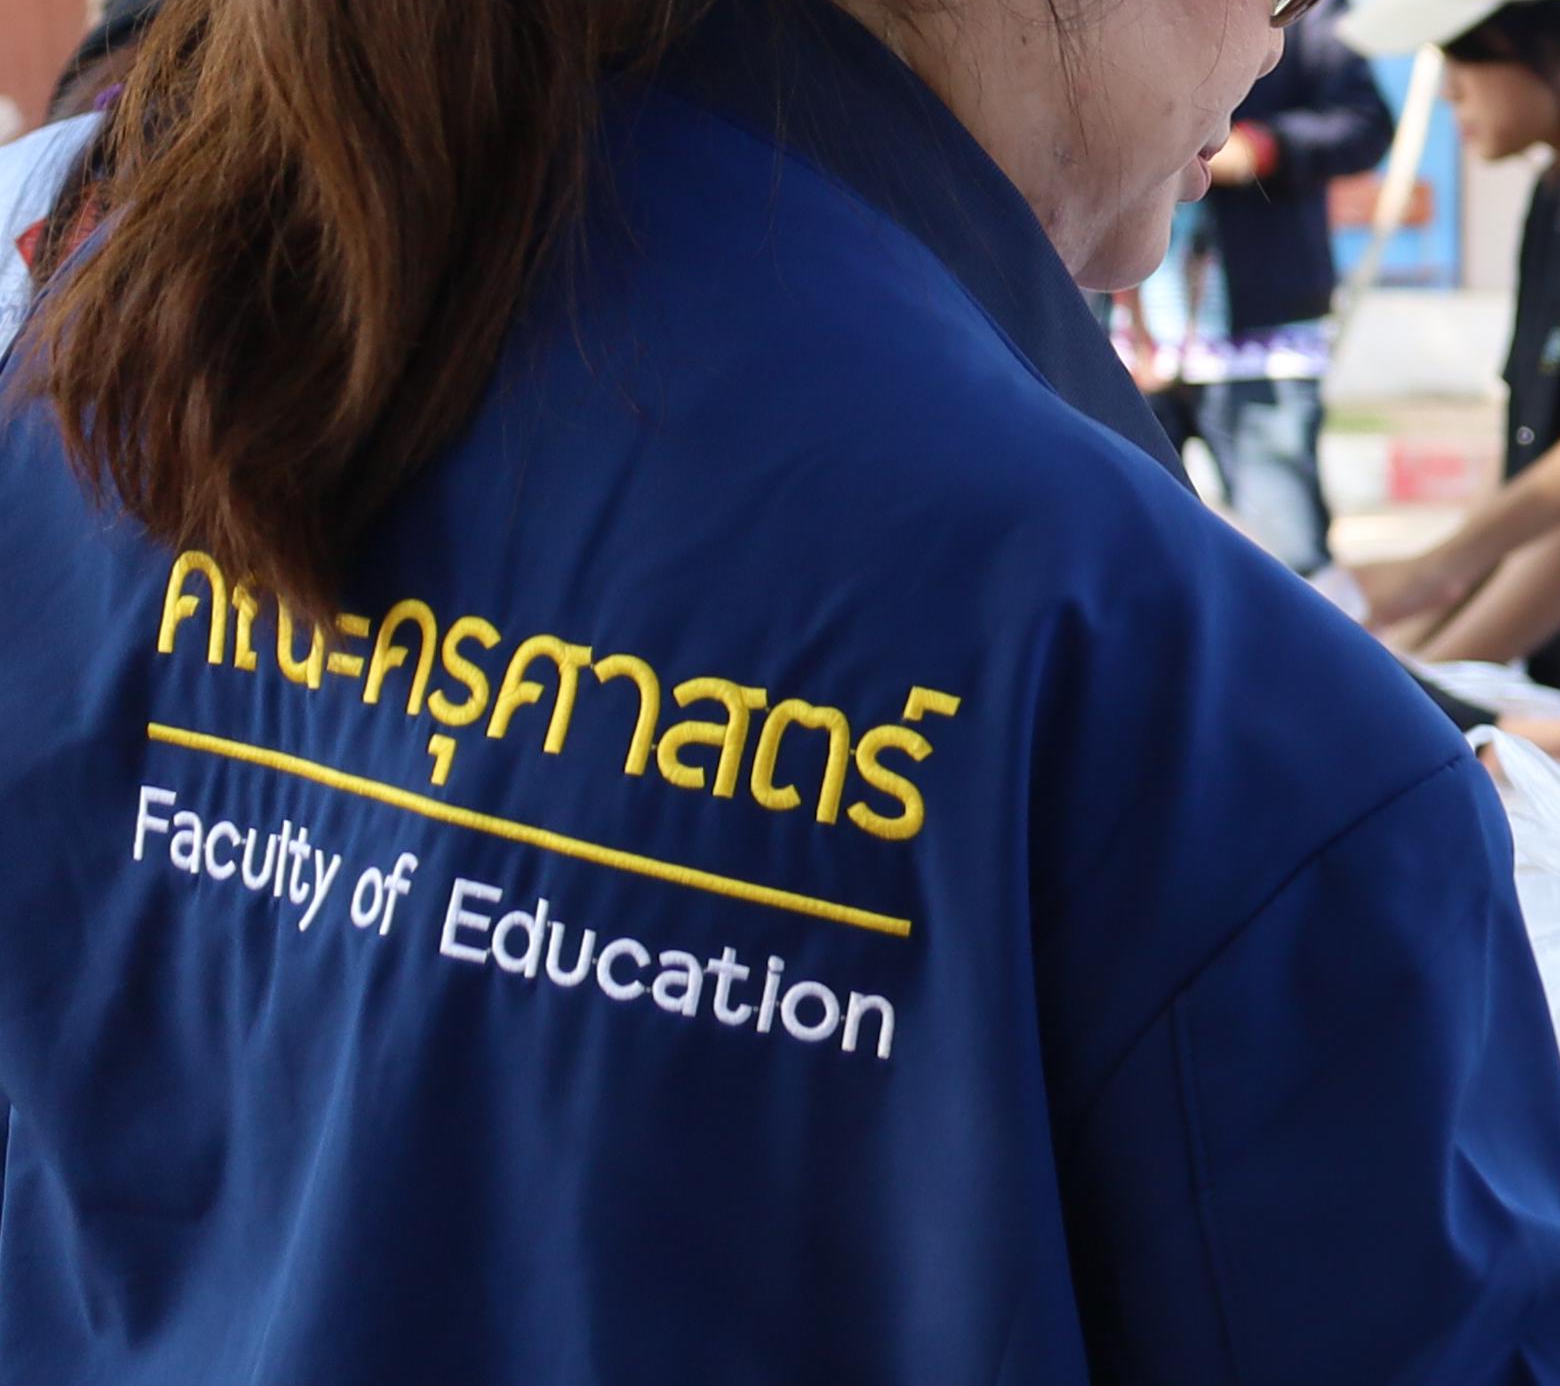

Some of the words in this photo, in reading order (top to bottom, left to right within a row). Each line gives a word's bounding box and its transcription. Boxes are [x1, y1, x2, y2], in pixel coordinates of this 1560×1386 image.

[132, 785, 341, 933] Faculty
[350, 853, 418, 936] of
[438, 877, 896, 1059] Education
